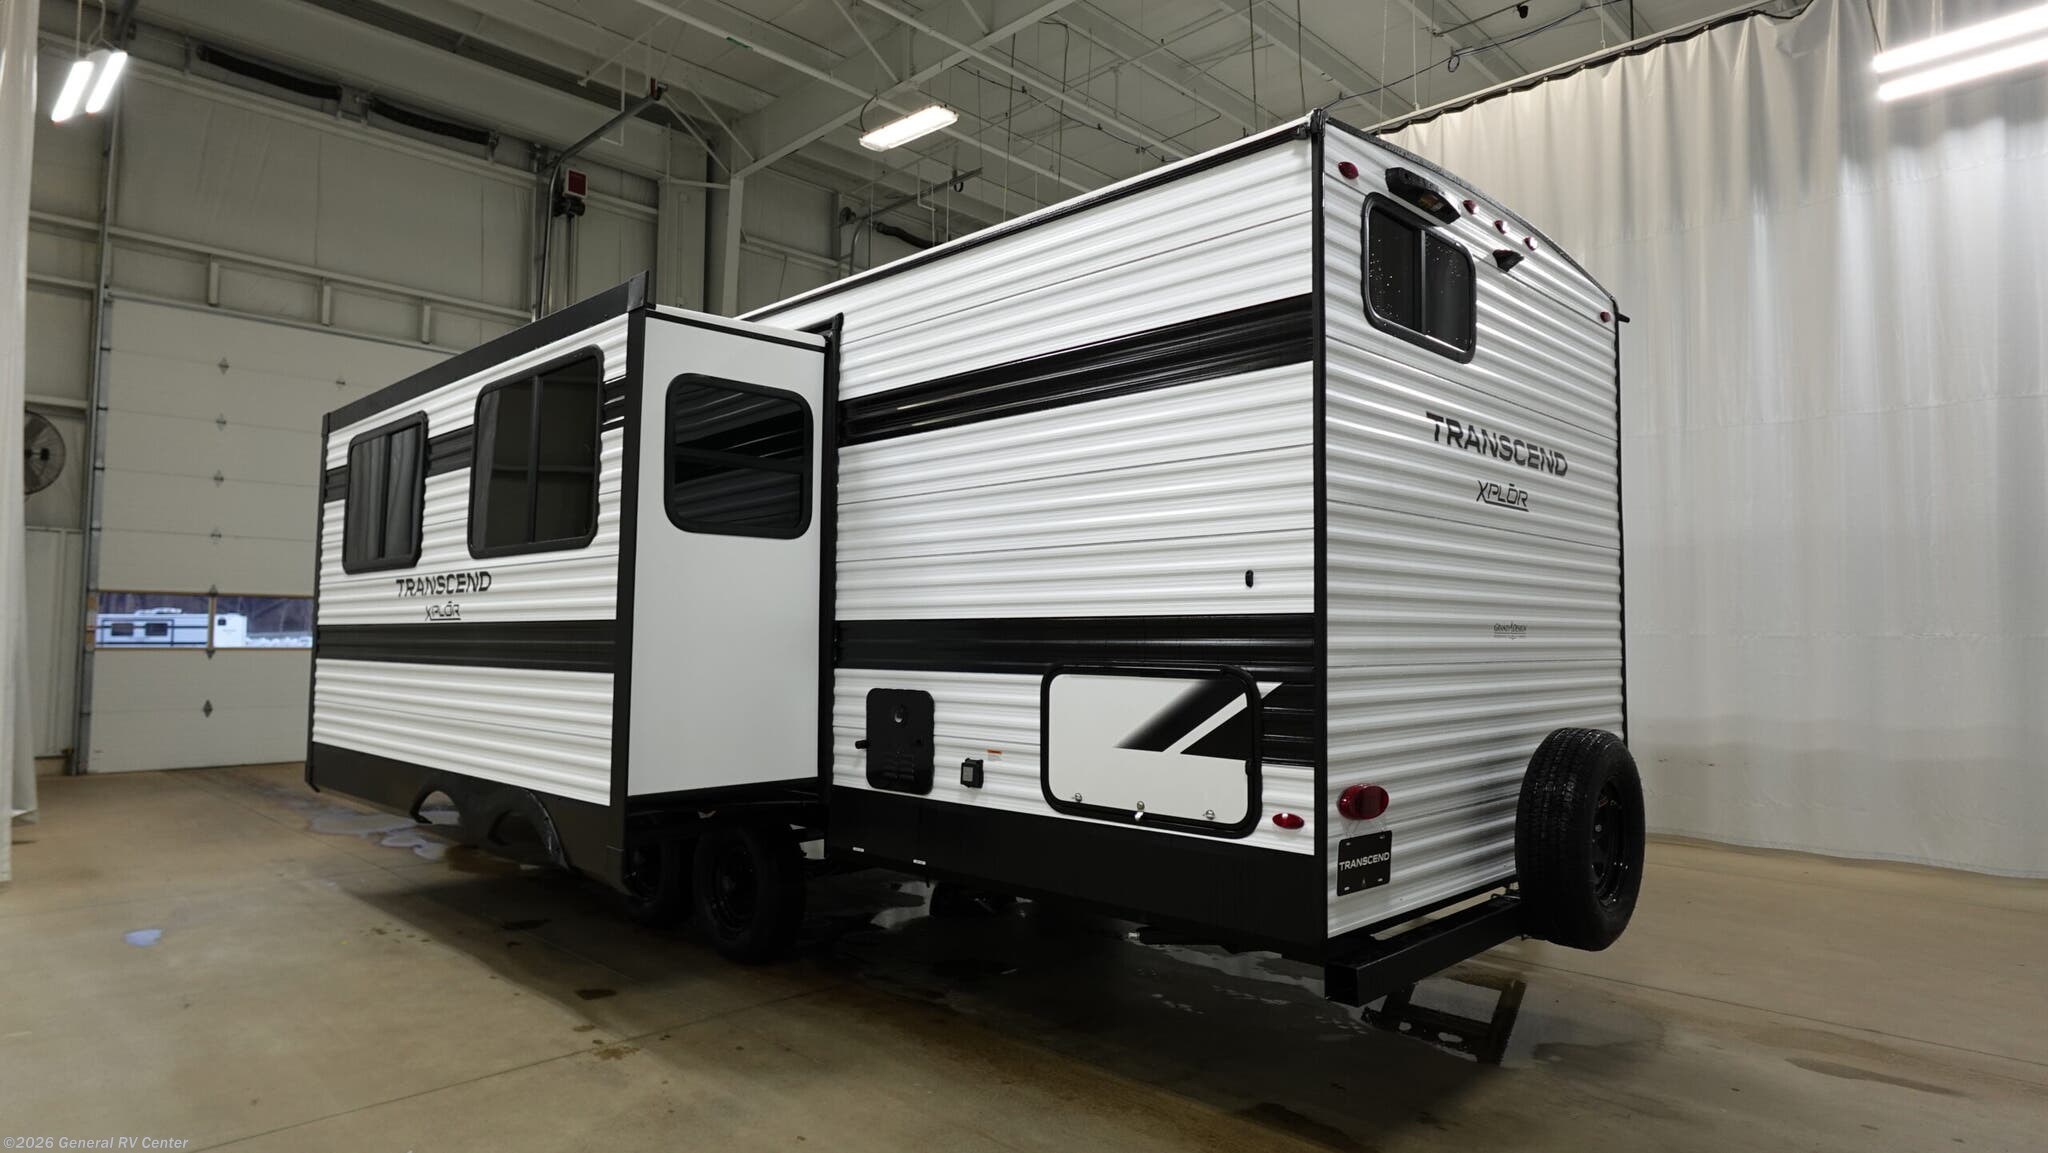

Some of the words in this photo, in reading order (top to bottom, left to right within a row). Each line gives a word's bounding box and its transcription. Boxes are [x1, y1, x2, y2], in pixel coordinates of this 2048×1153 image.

[1426, 411, 1568, 477] TRANSCEND
[396, 571, 492, 597] TRANSCEND
[1339, 852, 1390, 871] TRANSCEND
